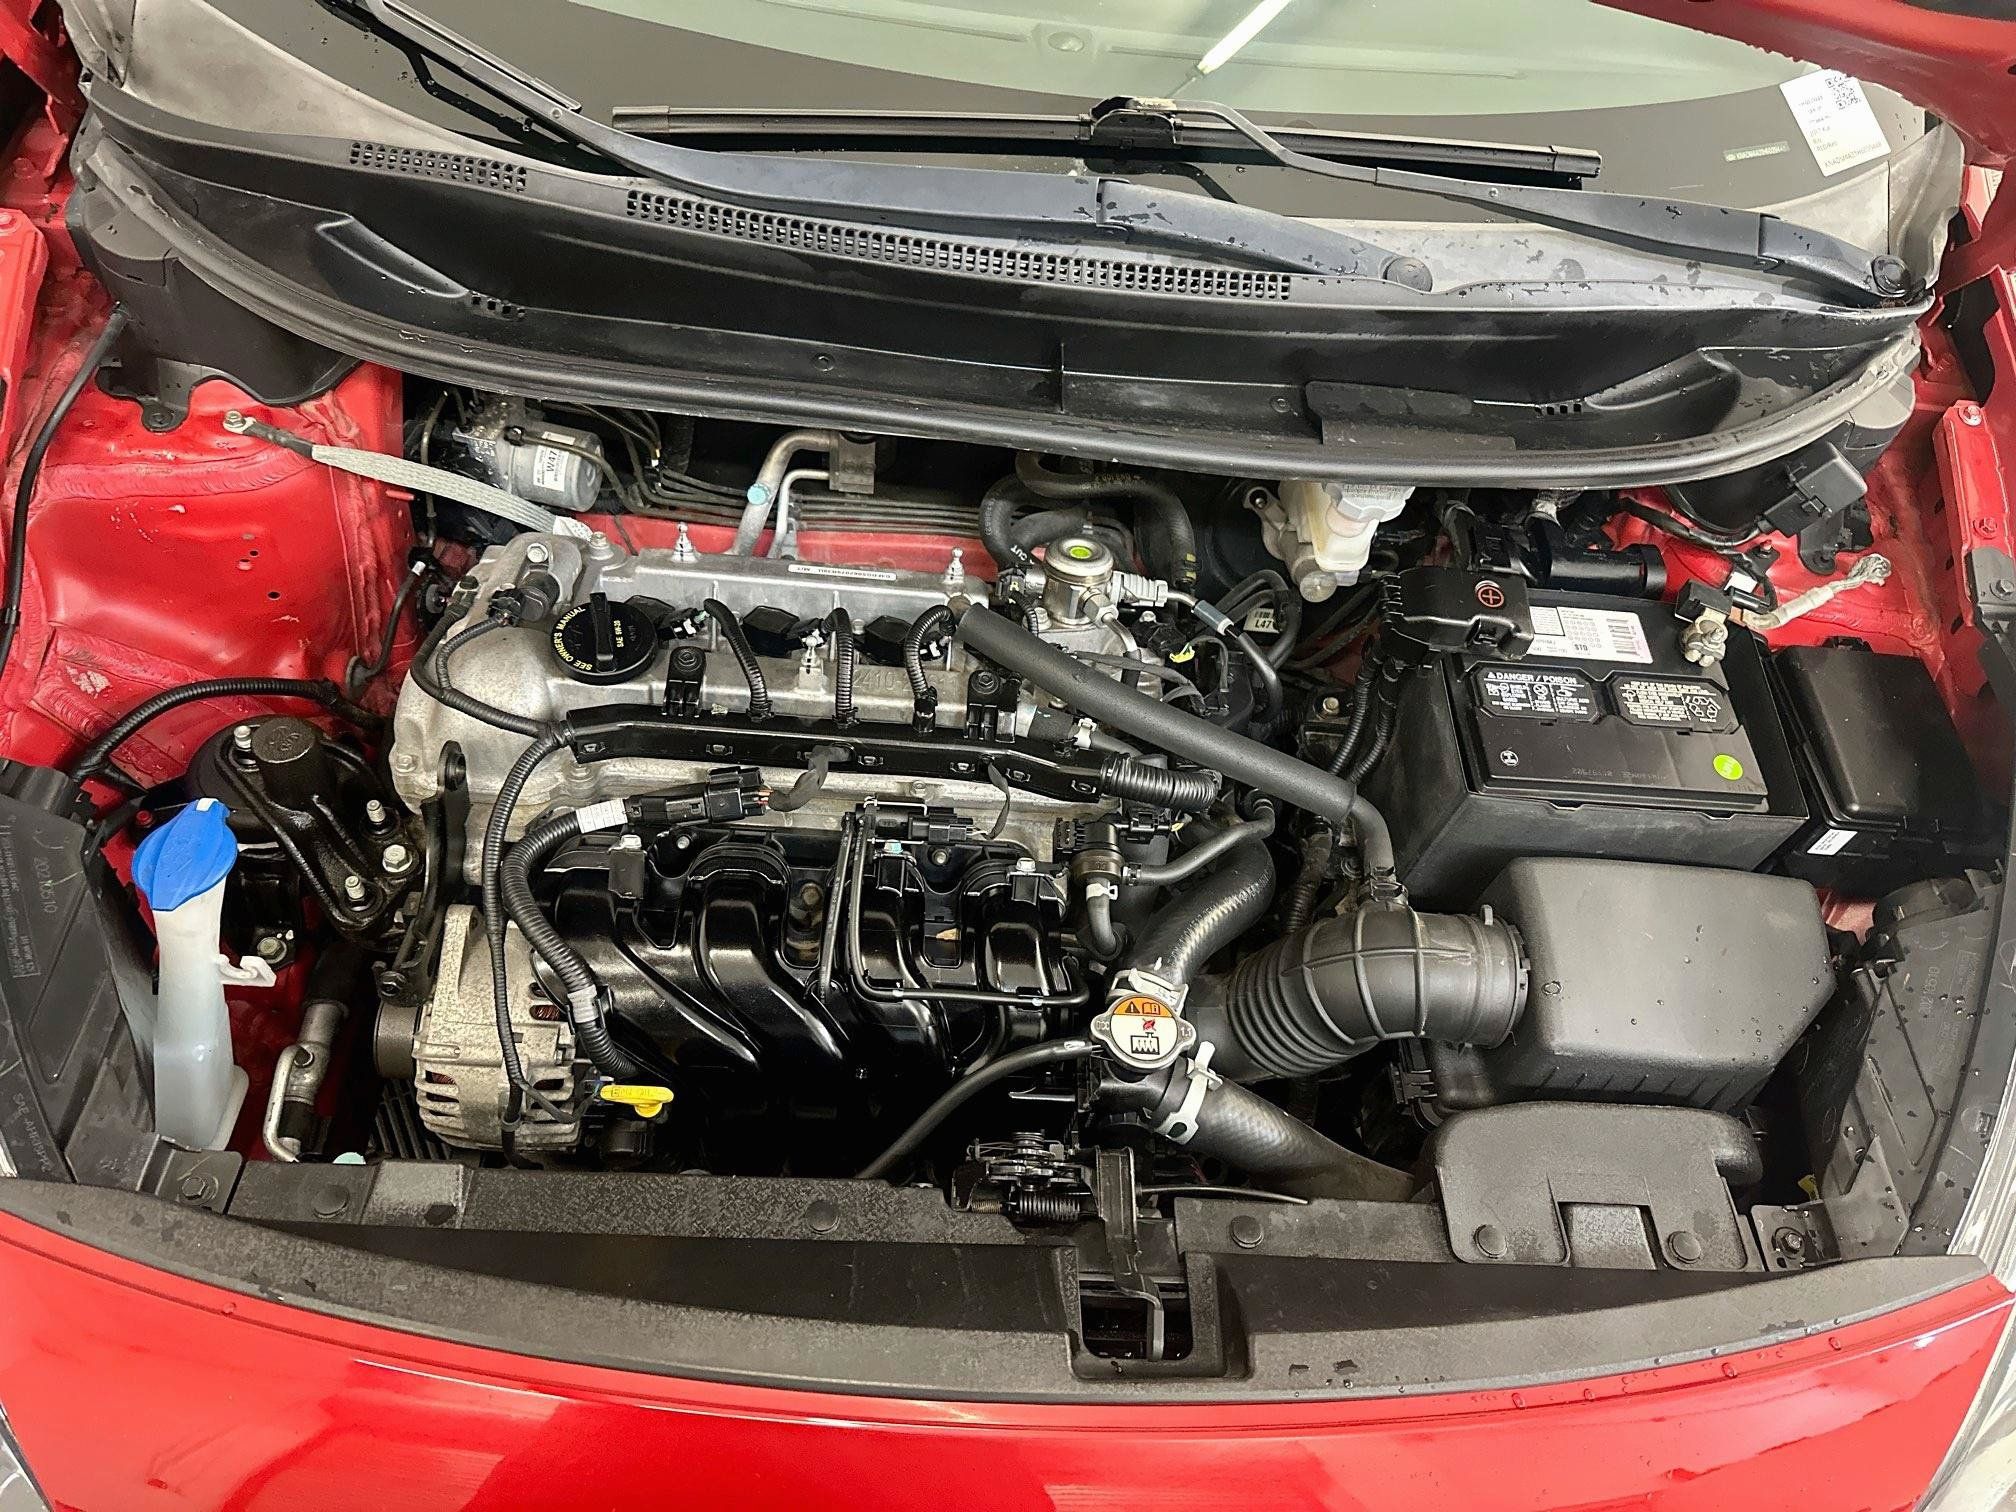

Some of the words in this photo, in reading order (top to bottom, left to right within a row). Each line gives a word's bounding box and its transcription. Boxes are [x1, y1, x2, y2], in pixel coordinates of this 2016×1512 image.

[1010, 544, 1028, 561] CUT
[555, 606, 586, 631] MANUAL
[553, 632, 574, 663] OWNER'S
[616, 636, 625, 648] SAE
[573, 659, 593, 671] SEE
[1496, 672, 1534, 682] DANGER
[1542, 675, 1577, 684] POISON
